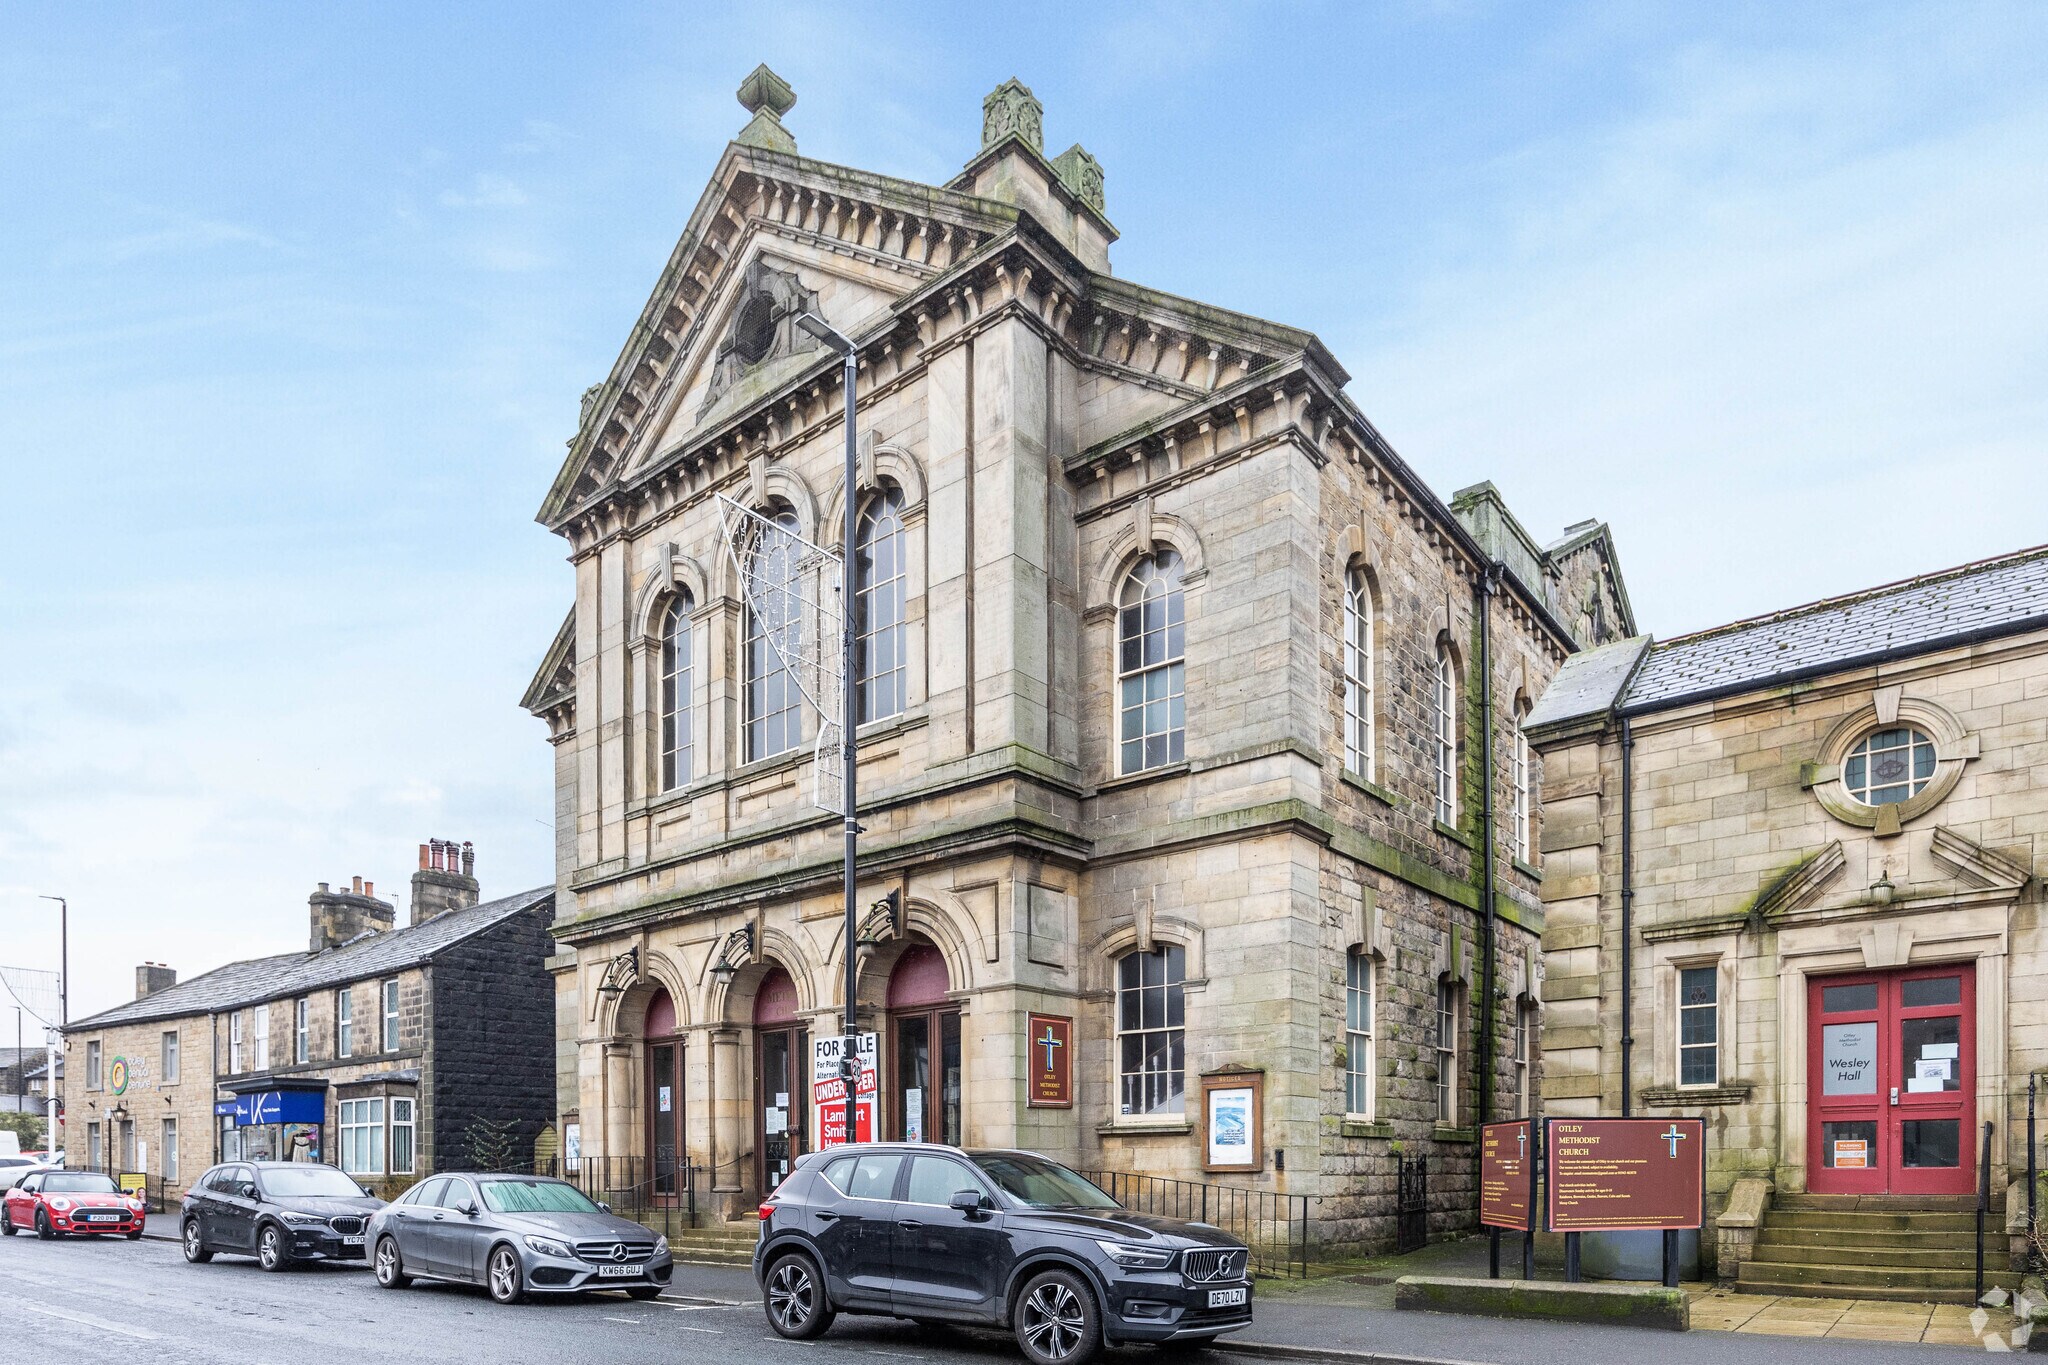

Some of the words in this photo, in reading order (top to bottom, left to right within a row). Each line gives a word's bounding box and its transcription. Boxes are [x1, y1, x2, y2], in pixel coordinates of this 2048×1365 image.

[816, 1040, 839, 1057] FOR
[844, 1037, 873, 1054] LE
[1829, 1058, 1870, 1069] Wesley
[853, 1064, 860, 1078] 20
[1838, 1070, 1861, 1081] Hall
[815, 1080, 845, 1101] UNDER
[824, 1108, 865, 1122] Lamrt
[824, 1124, 846, 1138] Smit
[602, 1266, 624, 1275] KW66
[626, 1266, 640, 1274] GUJ
[1212, 1292, 1229, 1304] DE70
